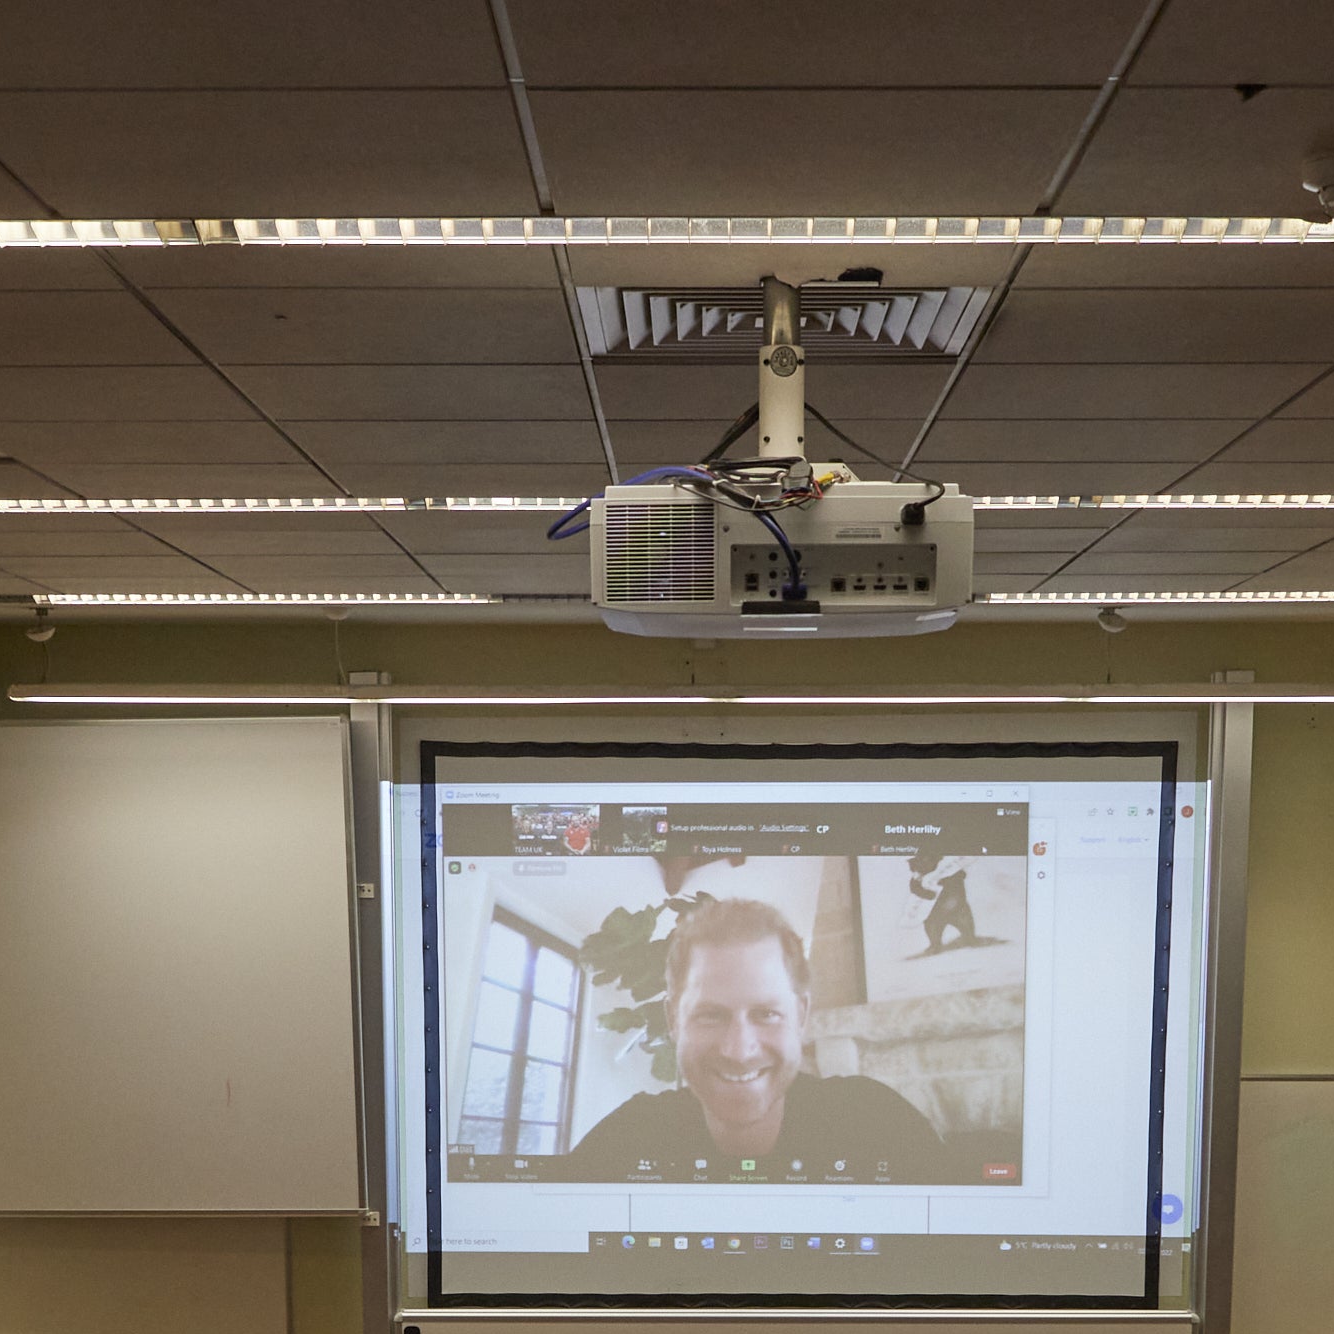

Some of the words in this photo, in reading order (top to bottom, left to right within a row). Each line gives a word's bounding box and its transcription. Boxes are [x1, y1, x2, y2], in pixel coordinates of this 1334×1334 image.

[456, 791, 474, 799] Zoom
[475, 791, 499, 800] Meeting
[671, 824, 688, 832] Setup
[690, 824, 727, 832] professional
[816, 825, 829, 834] CP
[885, 825, 906, 834] Beth
[907, 825, 941, 836] Herlihy
[702, 846, 716, 854] Toya
[880, 845, 895, 853] Beth
[896, 845, 918, 854] Herlihy
[1031, 1242, 1052, 1250] Partly
[1053, 1242, 1077, 1250] cloudy
